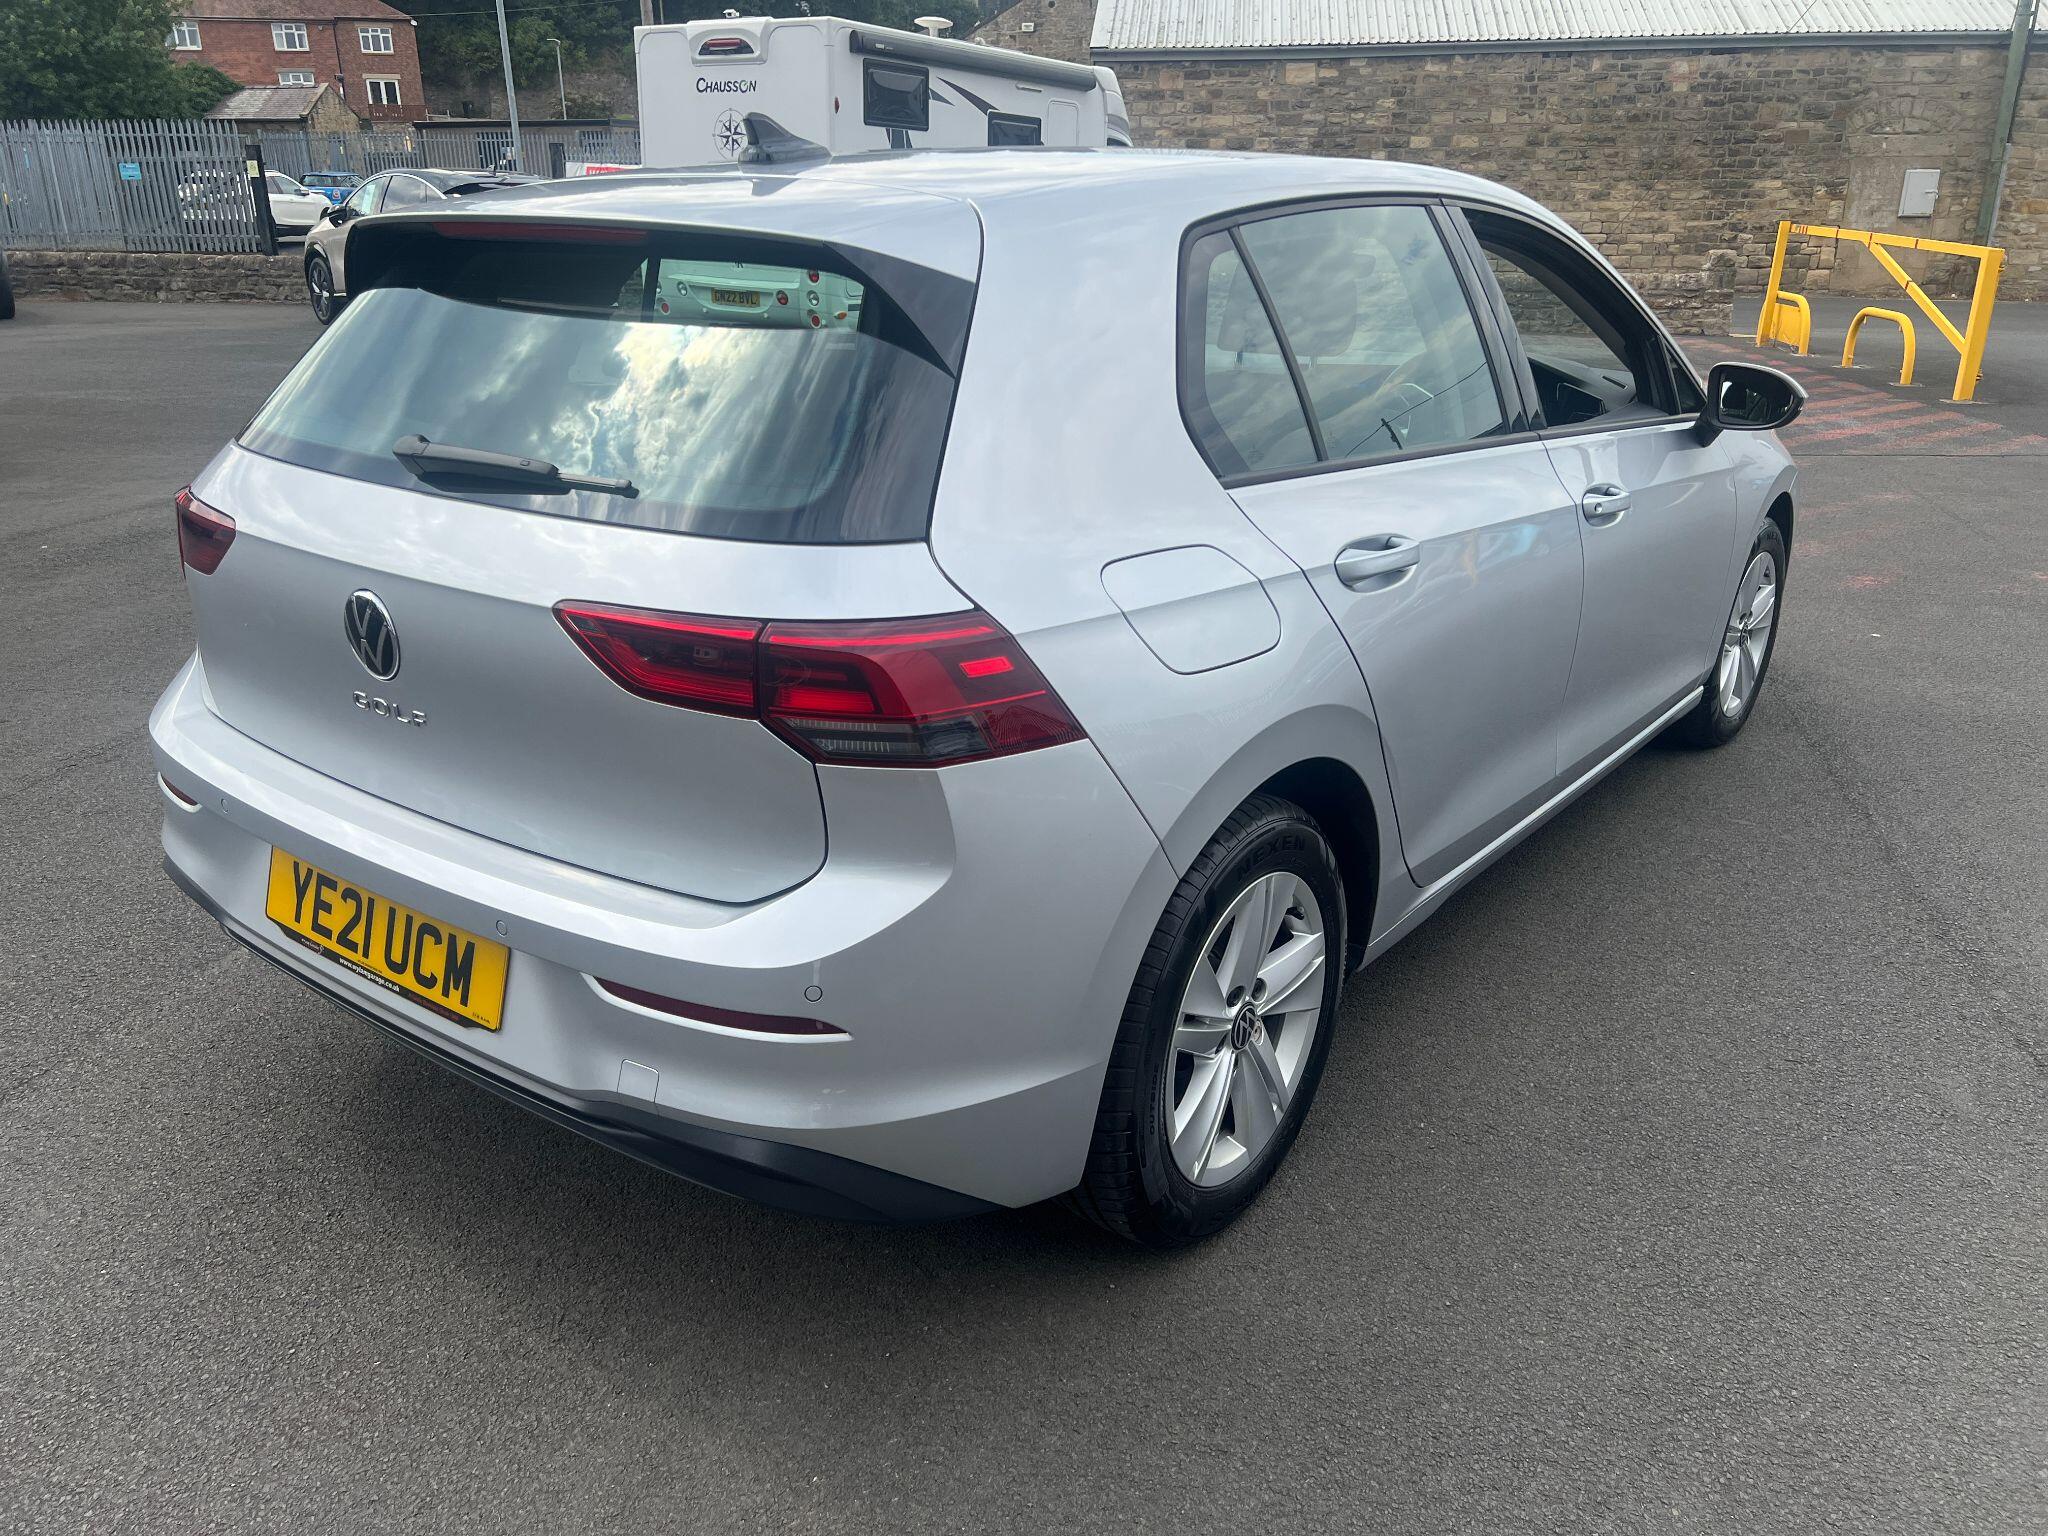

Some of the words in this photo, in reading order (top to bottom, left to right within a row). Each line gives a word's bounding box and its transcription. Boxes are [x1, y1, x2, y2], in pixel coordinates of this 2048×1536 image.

[696, 77, 757, 93] CHAUSSON
[353, 691, 428, 727] GOLF
[1236, 834, 1305, 881] NEXEN
[293, 860, 376, 960] YE21
[384, 905, 476, 1008] UCM
